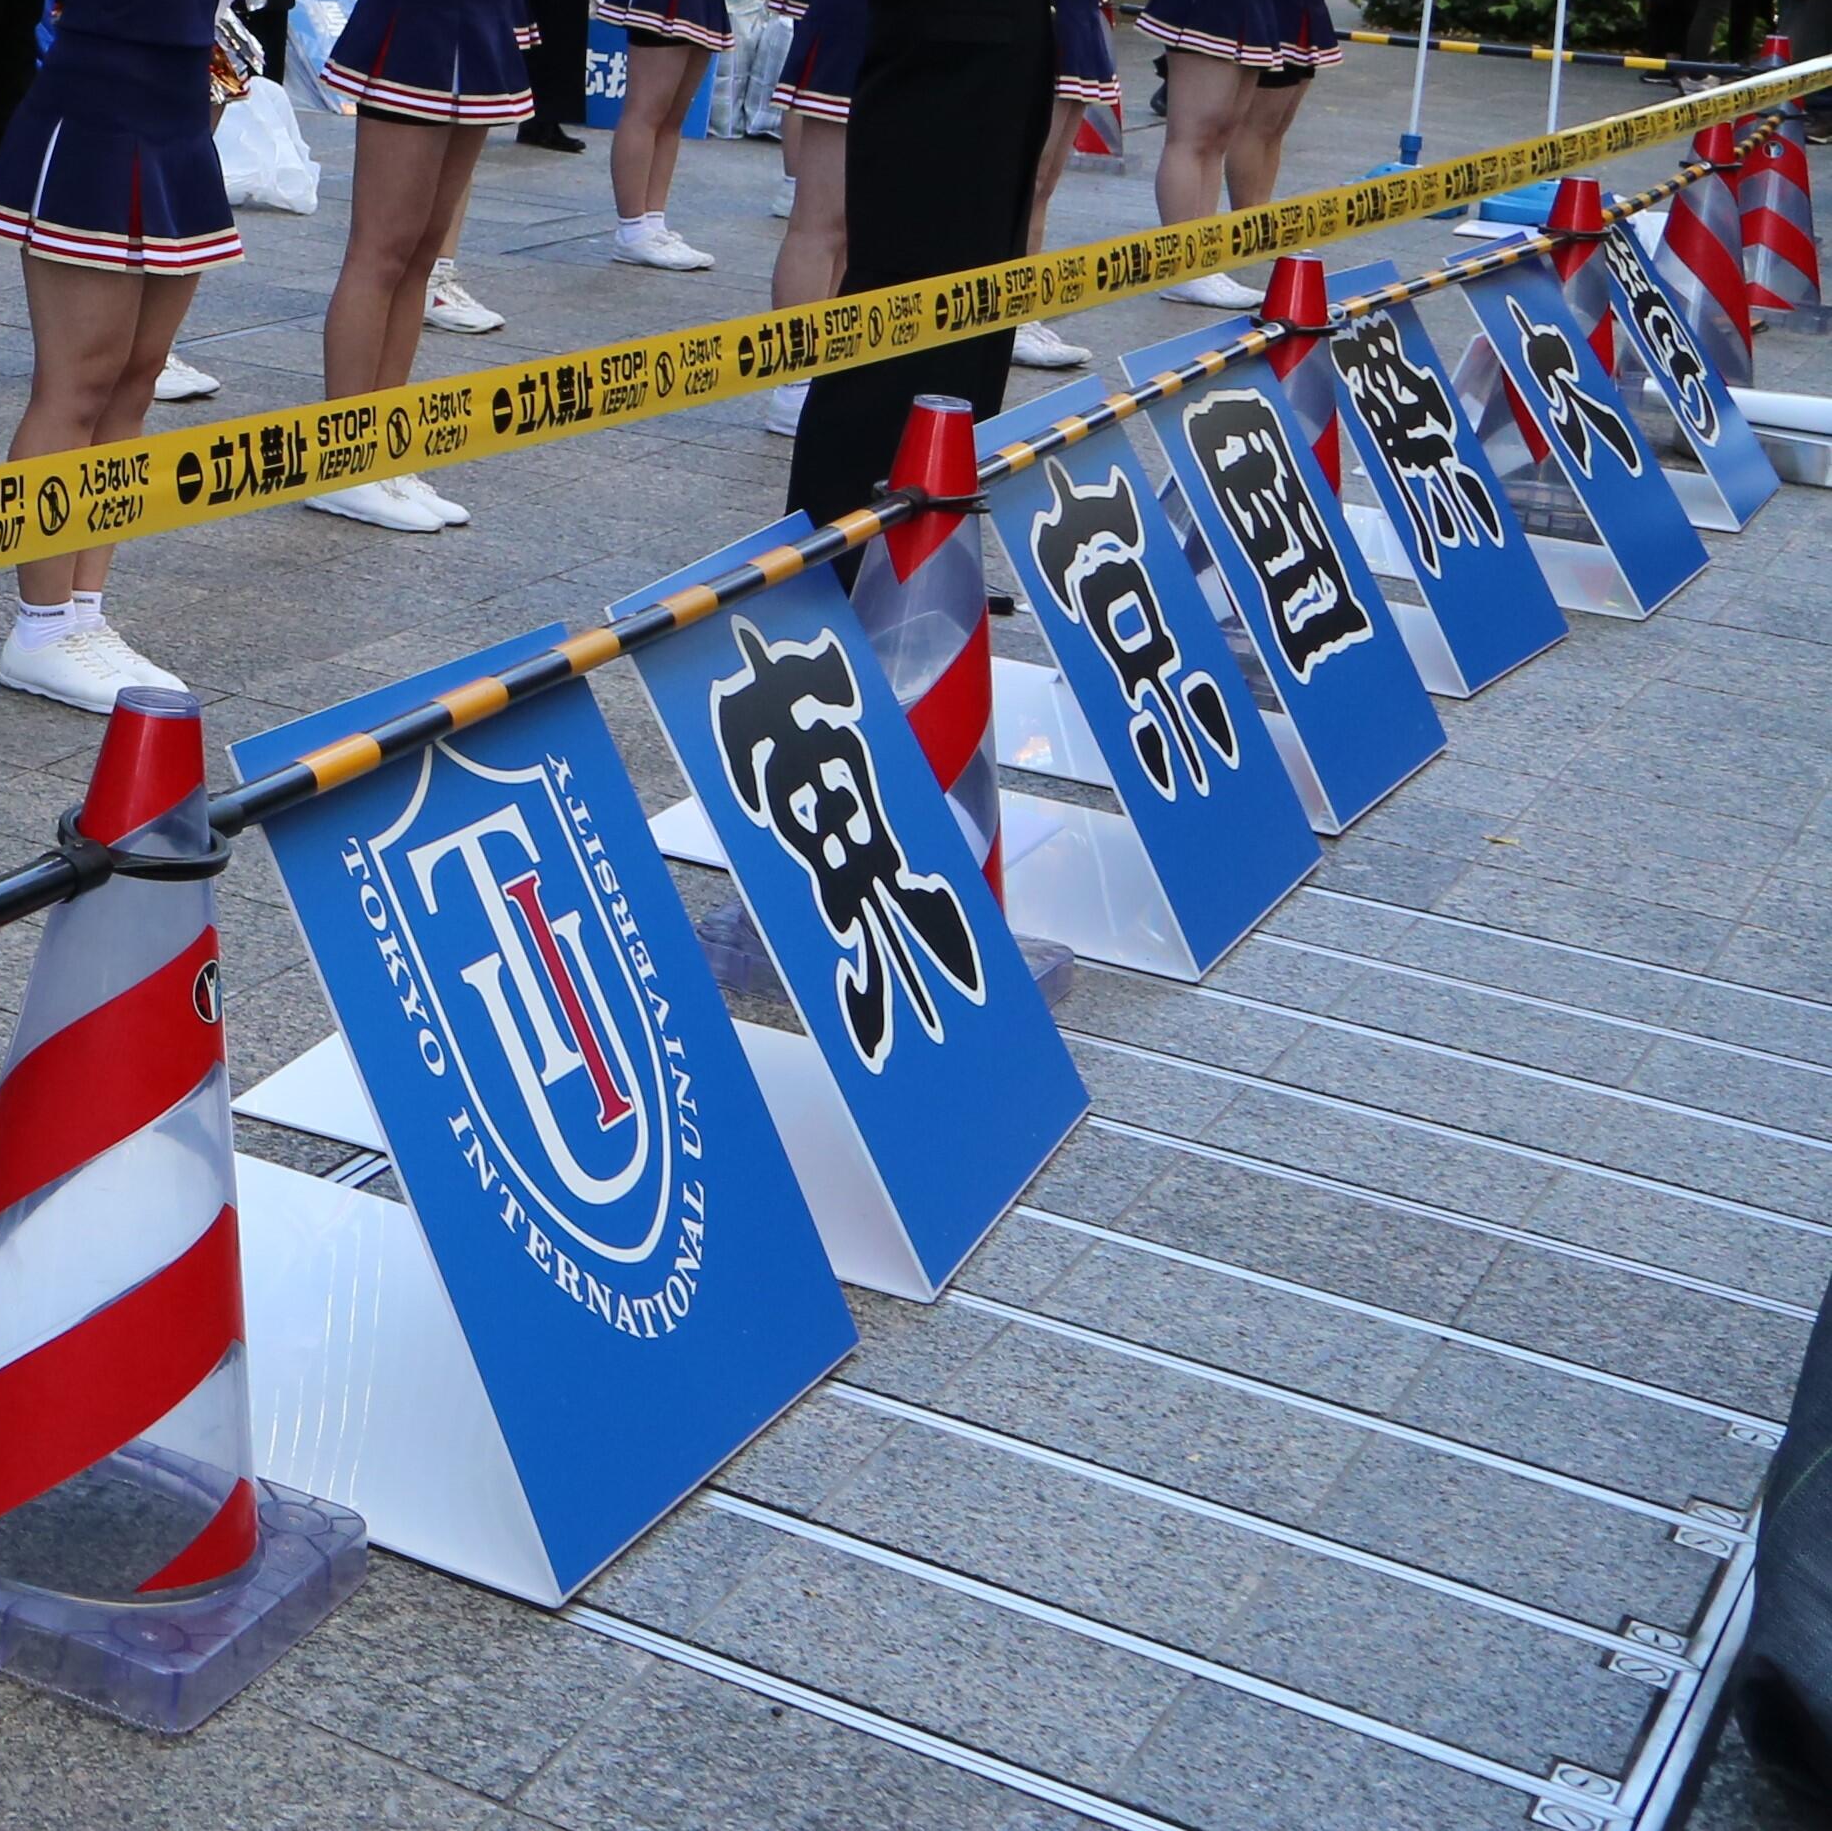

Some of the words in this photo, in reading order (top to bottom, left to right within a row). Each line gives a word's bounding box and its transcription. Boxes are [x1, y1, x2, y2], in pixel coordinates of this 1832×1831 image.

[1005, 266, 1037, 295] STOP!
[824, 304, 862, 337] STOP!
[601, 350, 647, 385] STOP!
[756, 315, 819, 378] 立入禁止
[419, 388, 471, 426] 入らないで
[516, 362, 593, 435] 立入禁止
[318, 406, 376, 447] STOP!
[425, 425, 467, 456] ください
[80, 453, 149, 498] 入らないで
[208, 420, 308, 505] 立入禁止
[87, 495, 143, 532] ください
[339, 835, 447, 1077] TOKYO
[545, 752, 707, 1161] UNIVERSITY
[447, 1106, 707, 1340] INTERNATIONAL
